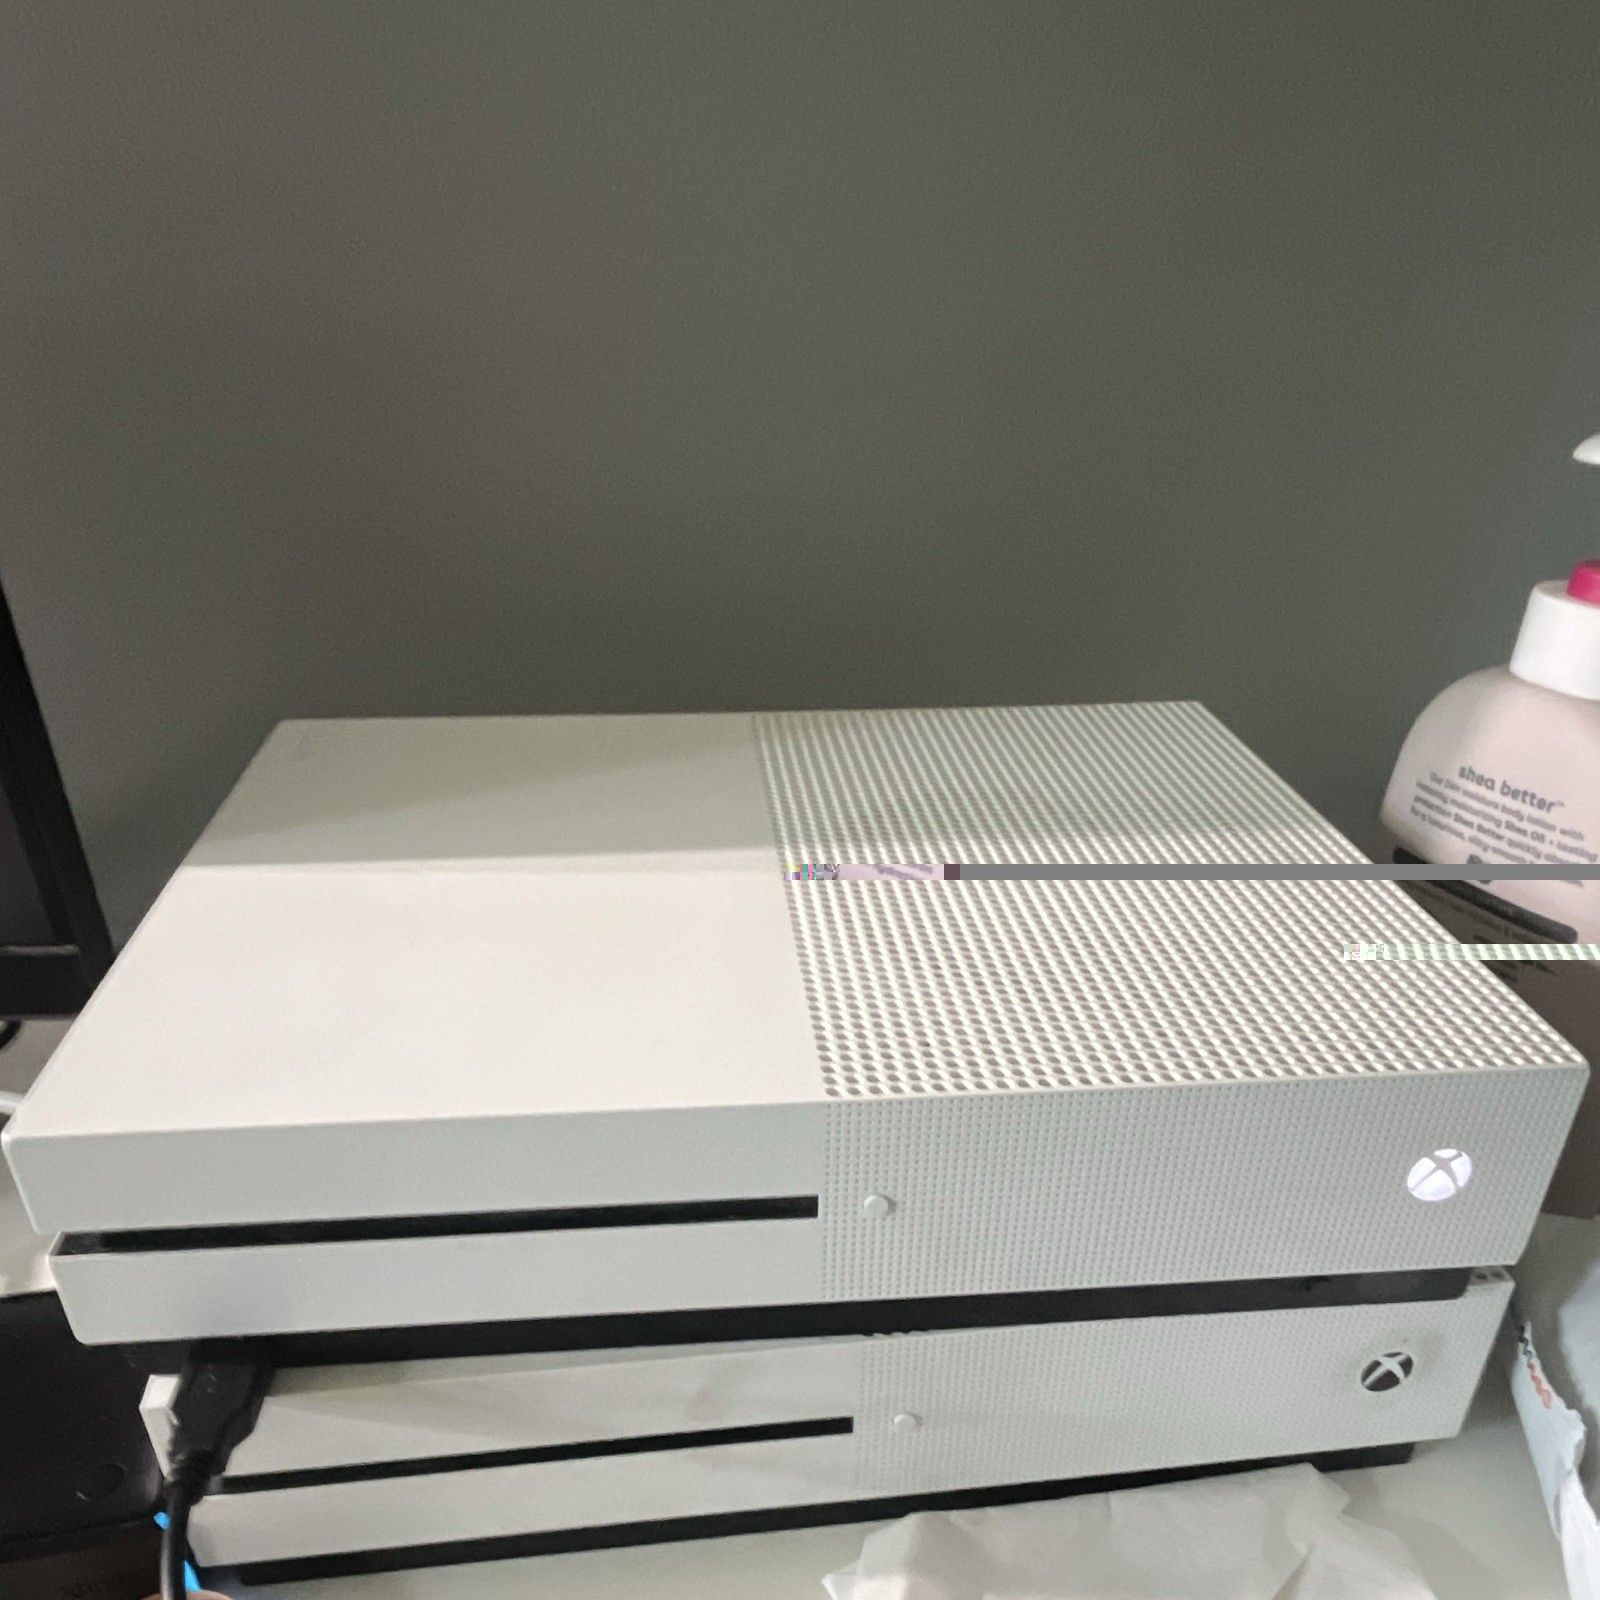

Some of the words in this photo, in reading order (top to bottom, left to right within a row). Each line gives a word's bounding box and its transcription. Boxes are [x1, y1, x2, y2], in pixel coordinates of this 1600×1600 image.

[1459, 766, 1495, 791] shea
[1500, 780, 1556, 813] better
[1559, 828, 1584, 841] with
